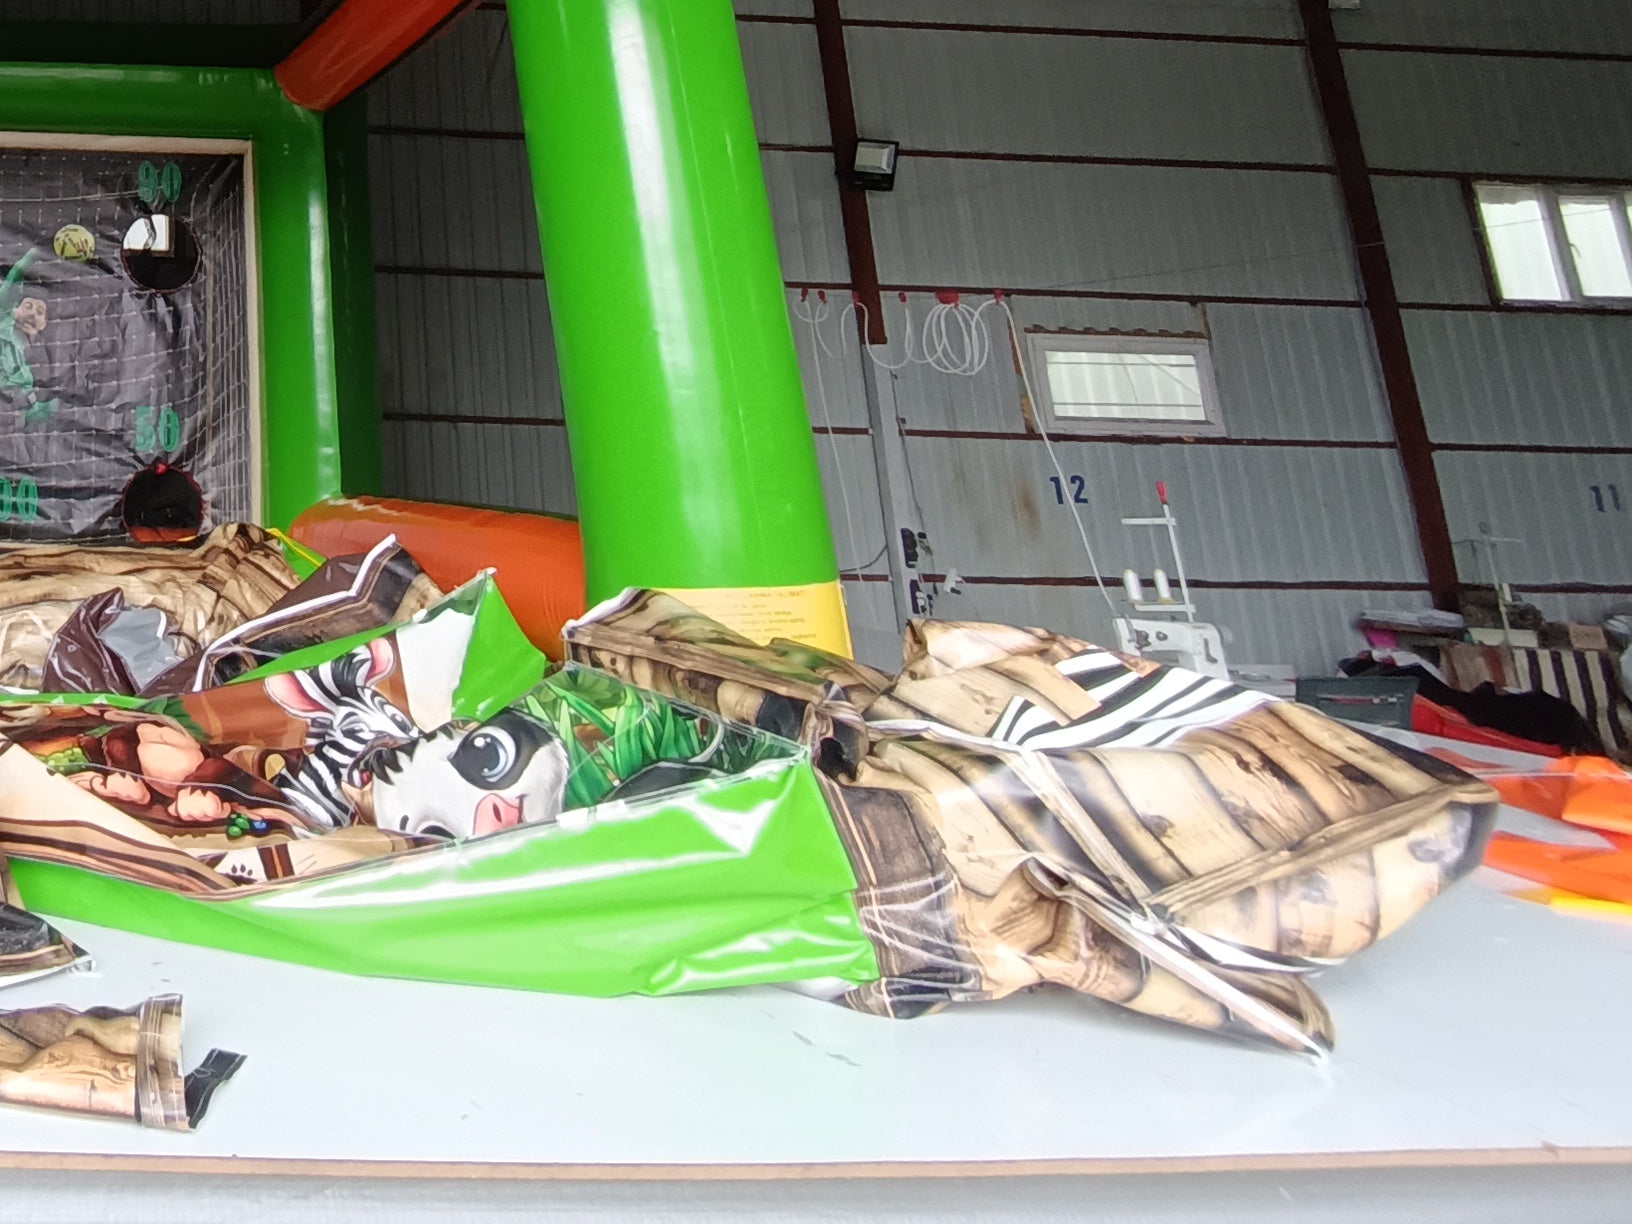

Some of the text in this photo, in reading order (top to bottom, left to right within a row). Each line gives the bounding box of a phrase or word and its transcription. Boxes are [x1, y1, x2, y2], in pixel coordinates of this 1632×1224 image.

[138, 160, 182, 203] 90
[135, 404, 180, 452] 50
[1049, 475, 1089, 505] 12
[1589, 483, 1621, 513] 11
